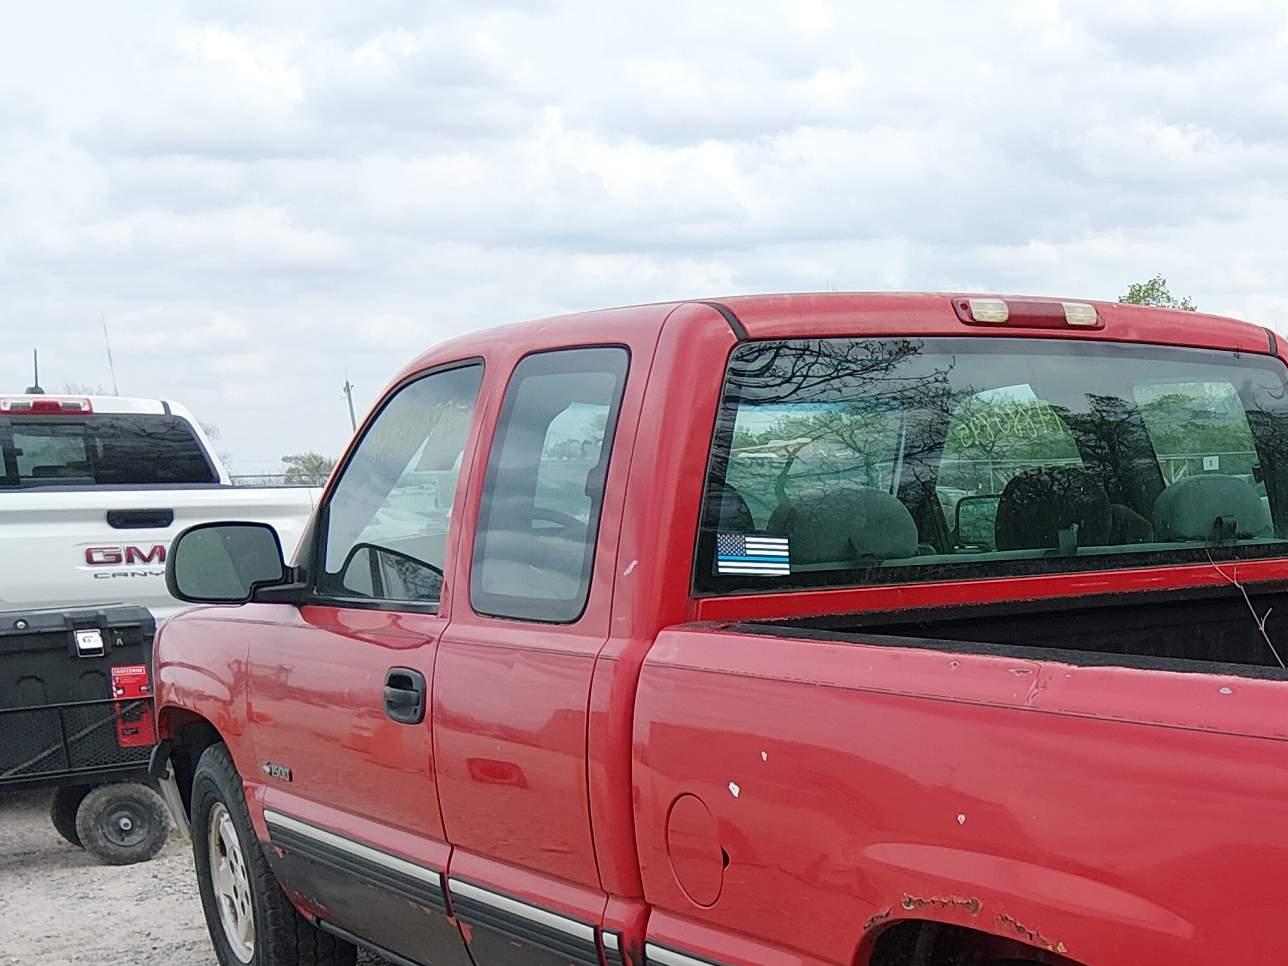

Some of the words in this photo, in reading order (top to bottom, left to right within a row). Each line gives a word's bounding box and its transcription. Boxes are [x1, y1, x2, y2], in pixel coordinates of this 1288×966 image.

[85, 544, 167, 565] GM
[94, 570, 166, 579] CANY
[270, 763, 291, 782] 1500
